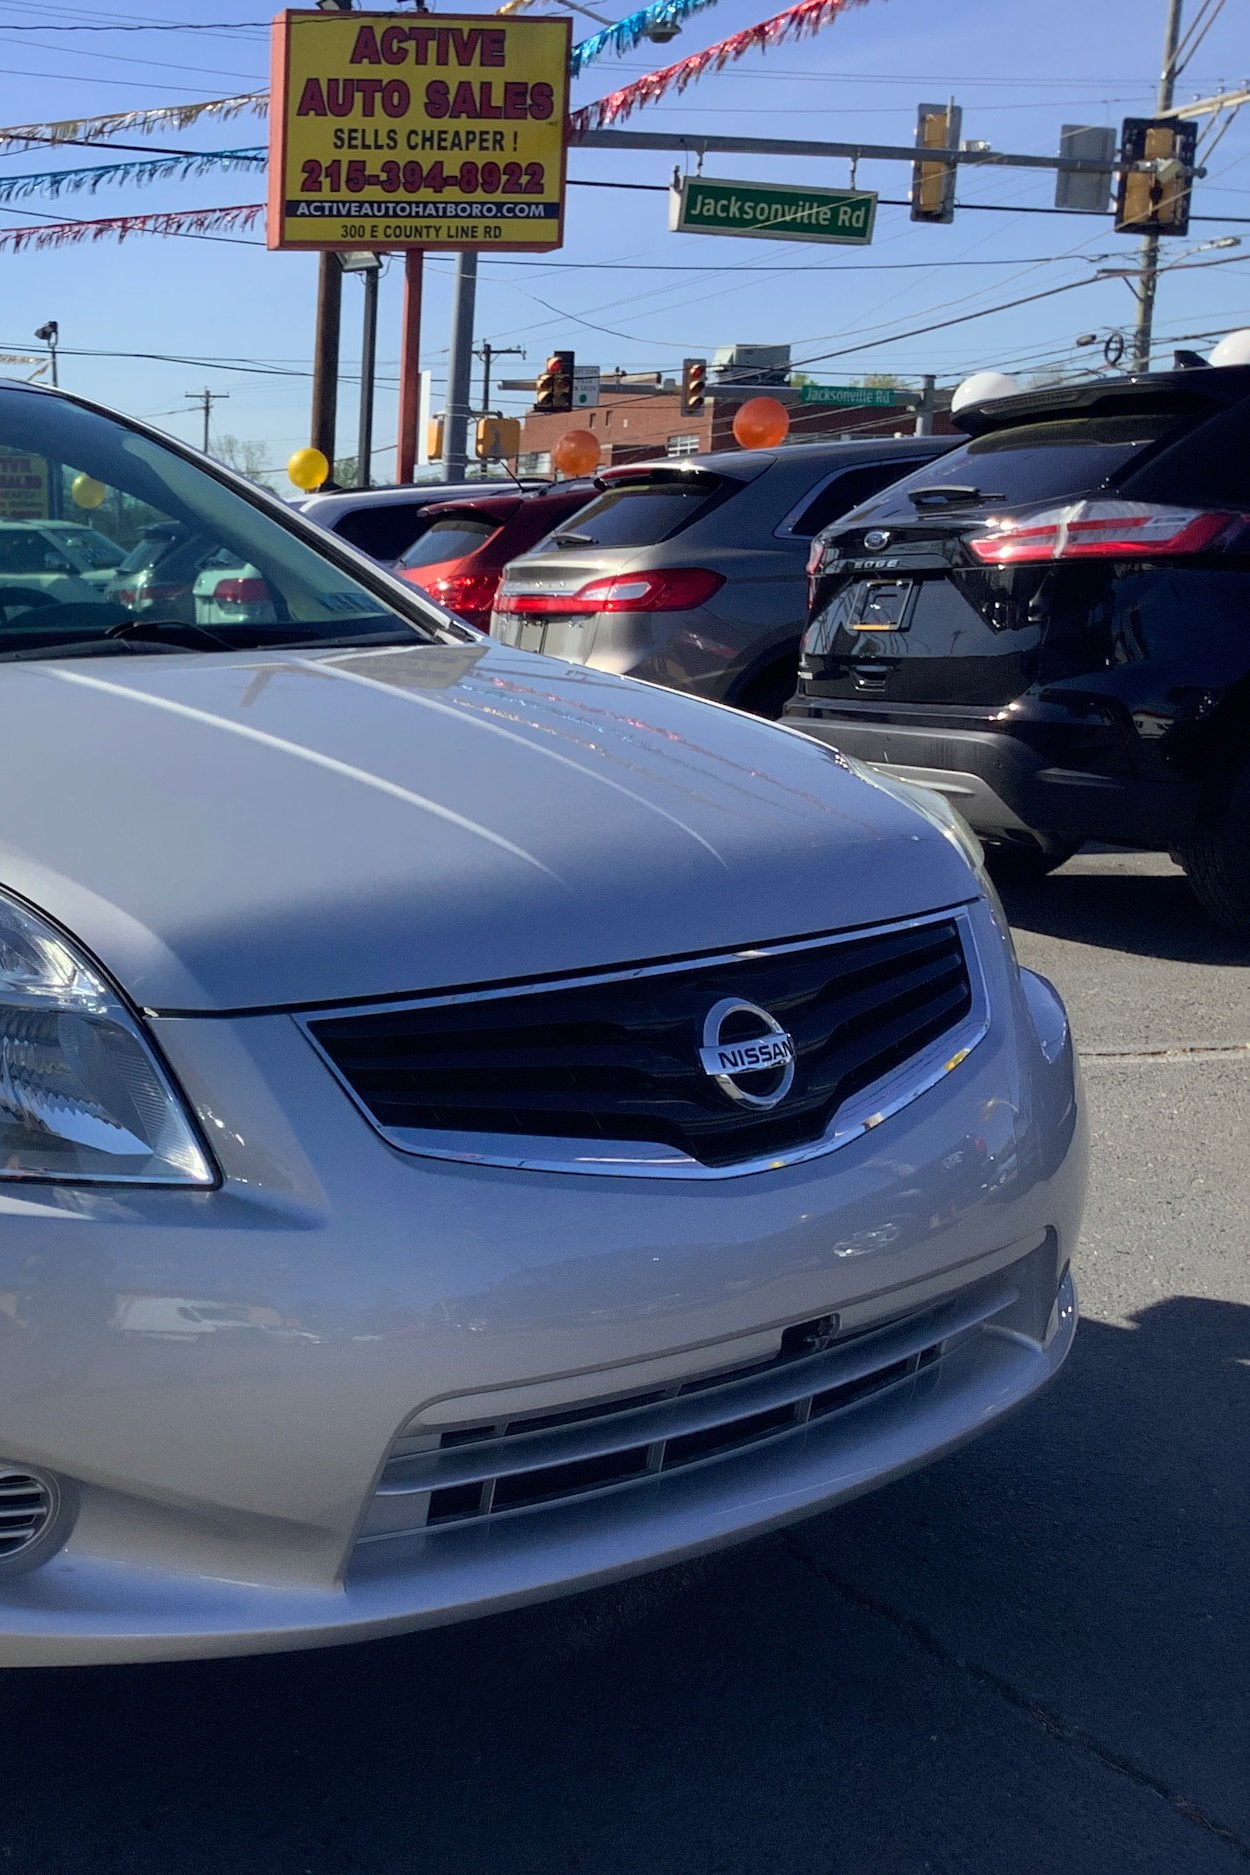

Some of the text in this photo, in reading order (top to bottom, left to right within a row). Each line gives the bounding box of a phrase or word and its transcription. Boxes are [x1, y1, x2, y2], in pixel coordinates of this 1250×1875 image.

[350, 26, 506, 67] ACTIVE
[296, 78, 554, 120] AUTO SALES
[333, 128, 398, 150] SELLS
[406, 130, 505, 151] CHEAPER
[300, 159, 544, 194] 215-394-8922
[297, 202, 545, 218] ACTIVEAUTOHATBORO.COM
[691, 195, 865, 228] Jacksonville Rd
[341, 225, 502, 239] 300 E COUNTY LINE RD
[806, 387, 890, 404] Jacksonville Rd
[854, 559, 900, 569] EDGE
[718, 1039, 793, 1069] NISSAN
